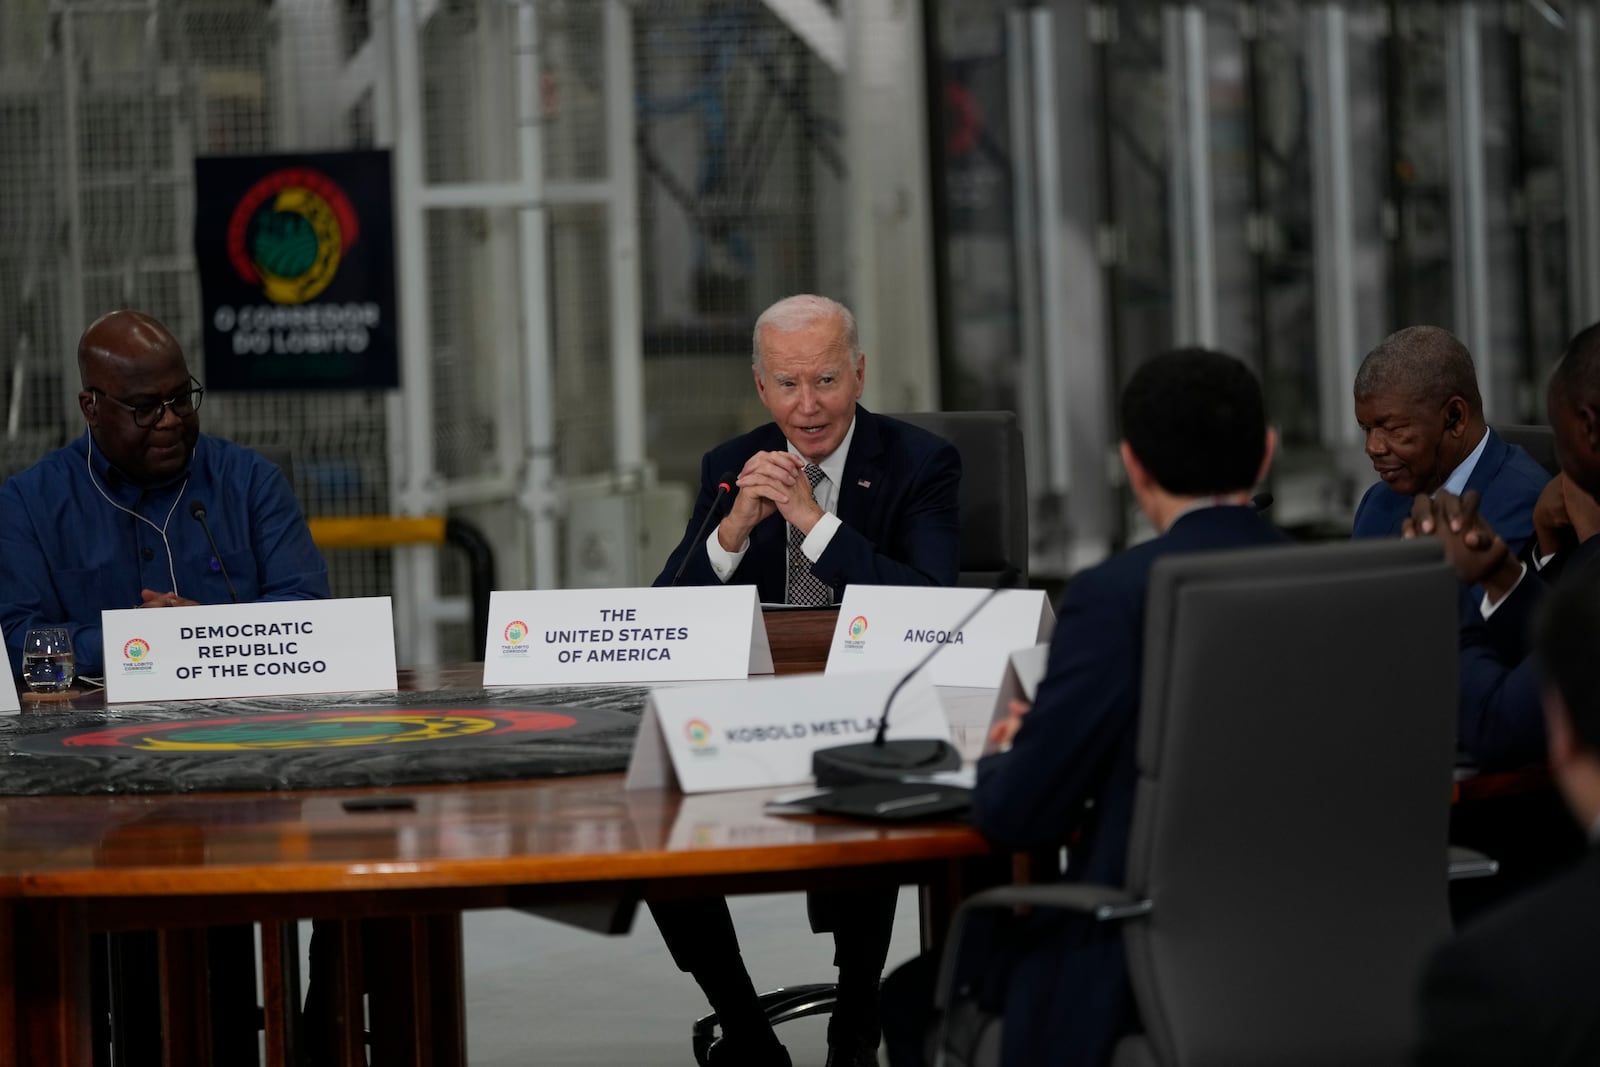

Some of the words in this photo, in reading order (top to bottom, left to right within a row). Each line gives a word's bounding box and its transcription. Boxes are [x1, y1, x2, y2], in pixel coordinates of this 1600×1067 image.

[214, 305, 234, 331] O
[239, 302, 379, 328] CORREDOR
[233, 329, 270, 353] DO
[274, 328, 369, 353] LOBITO
[600, 609, 636, 622] THE
[180, 621, 313, 640] DEMOCRATIC
[545, 629, 614, 644] UNITED
[618, 627, 689, 641] STATES
[904, 629, 964, 645] ANGOLA
[198, 641, 298, 659] REPUBLIC
[558, 650, 582, 663] OF
[586, 647, 671, 662] AMERICA
[176, 665, 202, 680] OF
[208, 663, 248, 677] THE
[254, 660, 326, 676] CONGO
[725, 722, 806, 743] KOBOLD
